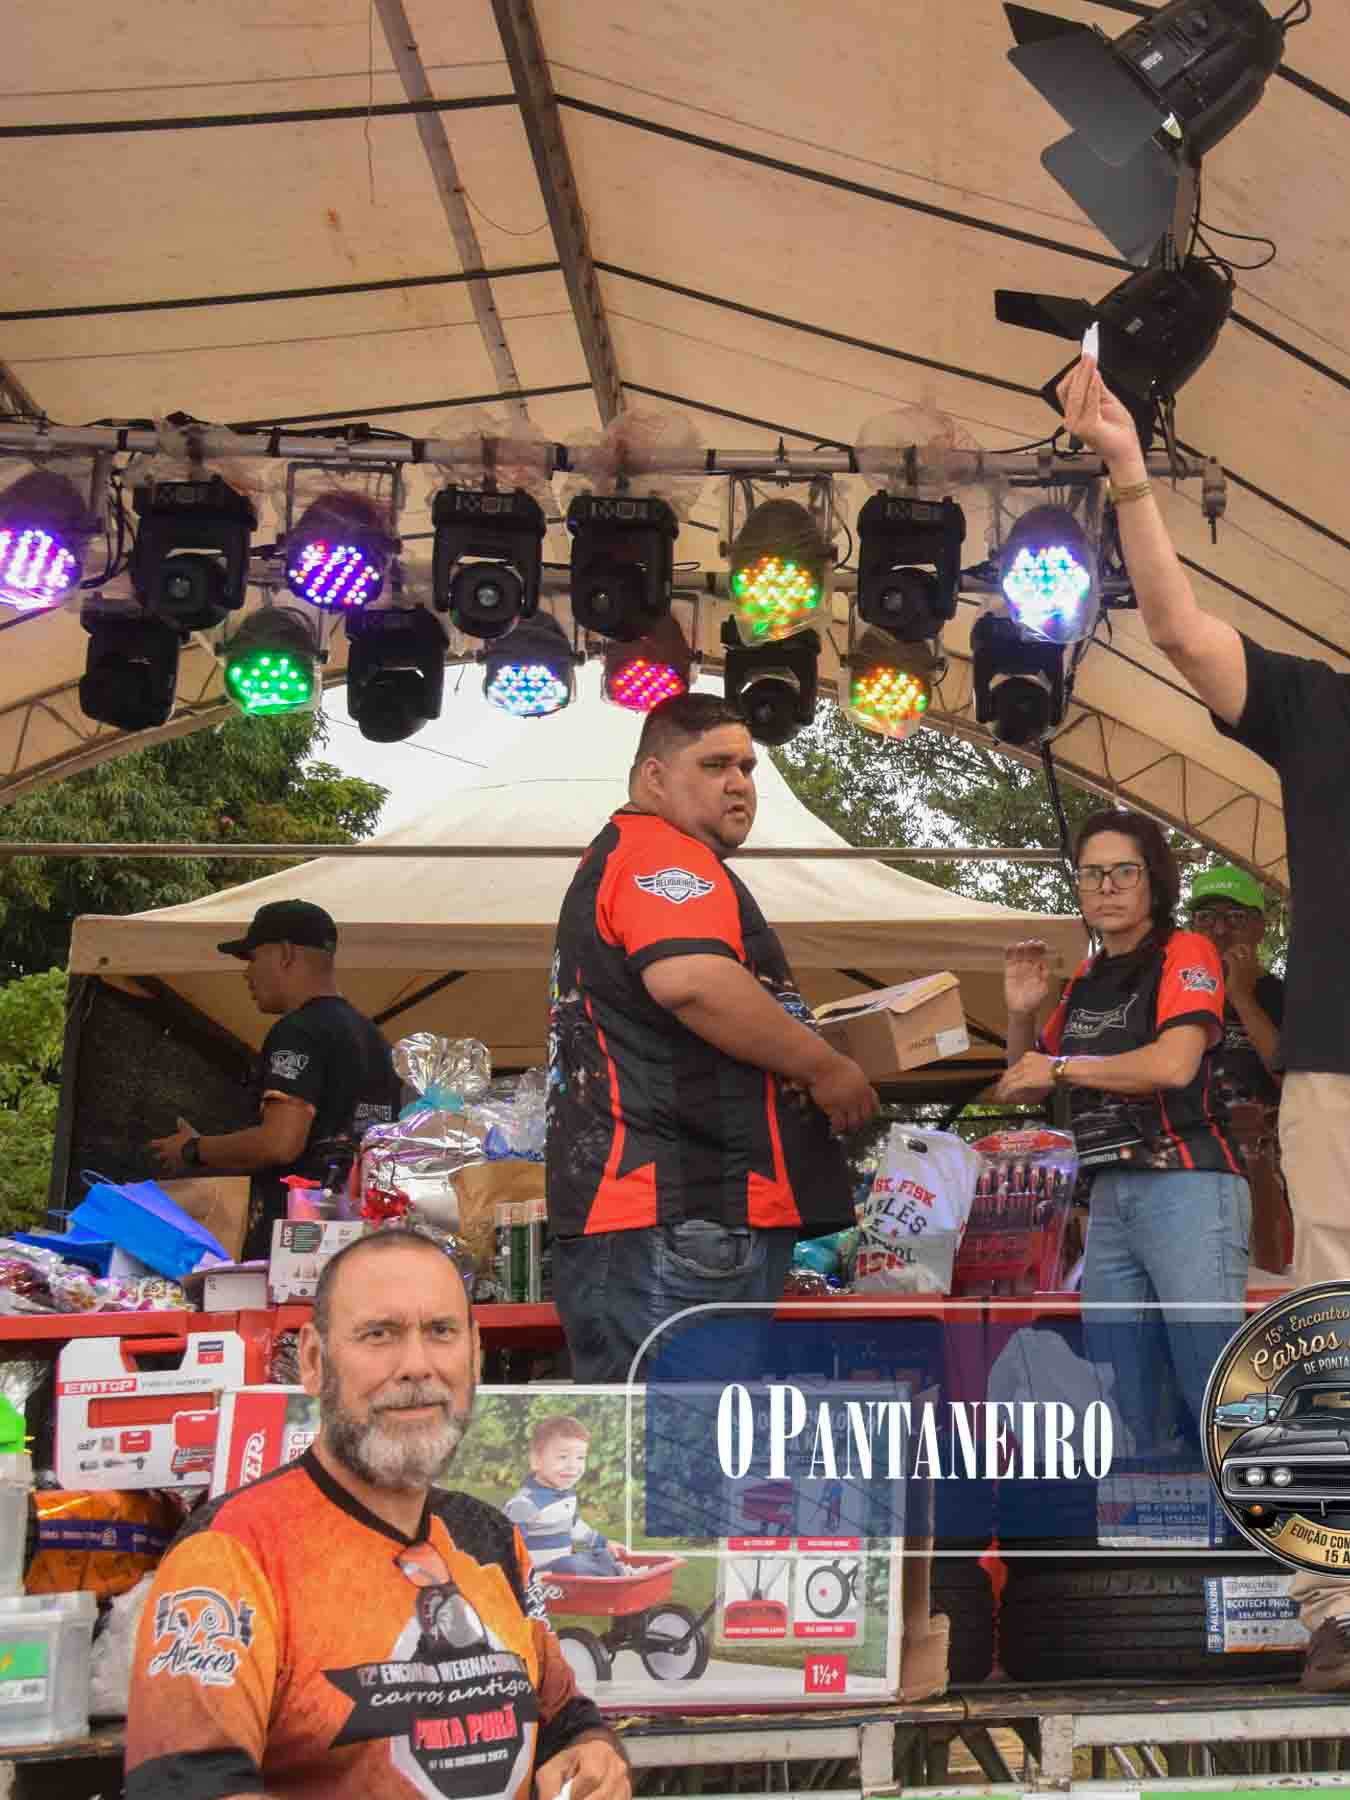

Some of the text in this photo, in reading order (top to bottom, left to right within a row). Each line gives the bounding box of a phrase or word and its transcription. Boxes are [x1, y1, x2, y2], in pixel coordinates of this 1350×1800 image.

[63, 1380, 135, 1394] EMTOP
[371, 1677, 532, 1707] carros antigos
